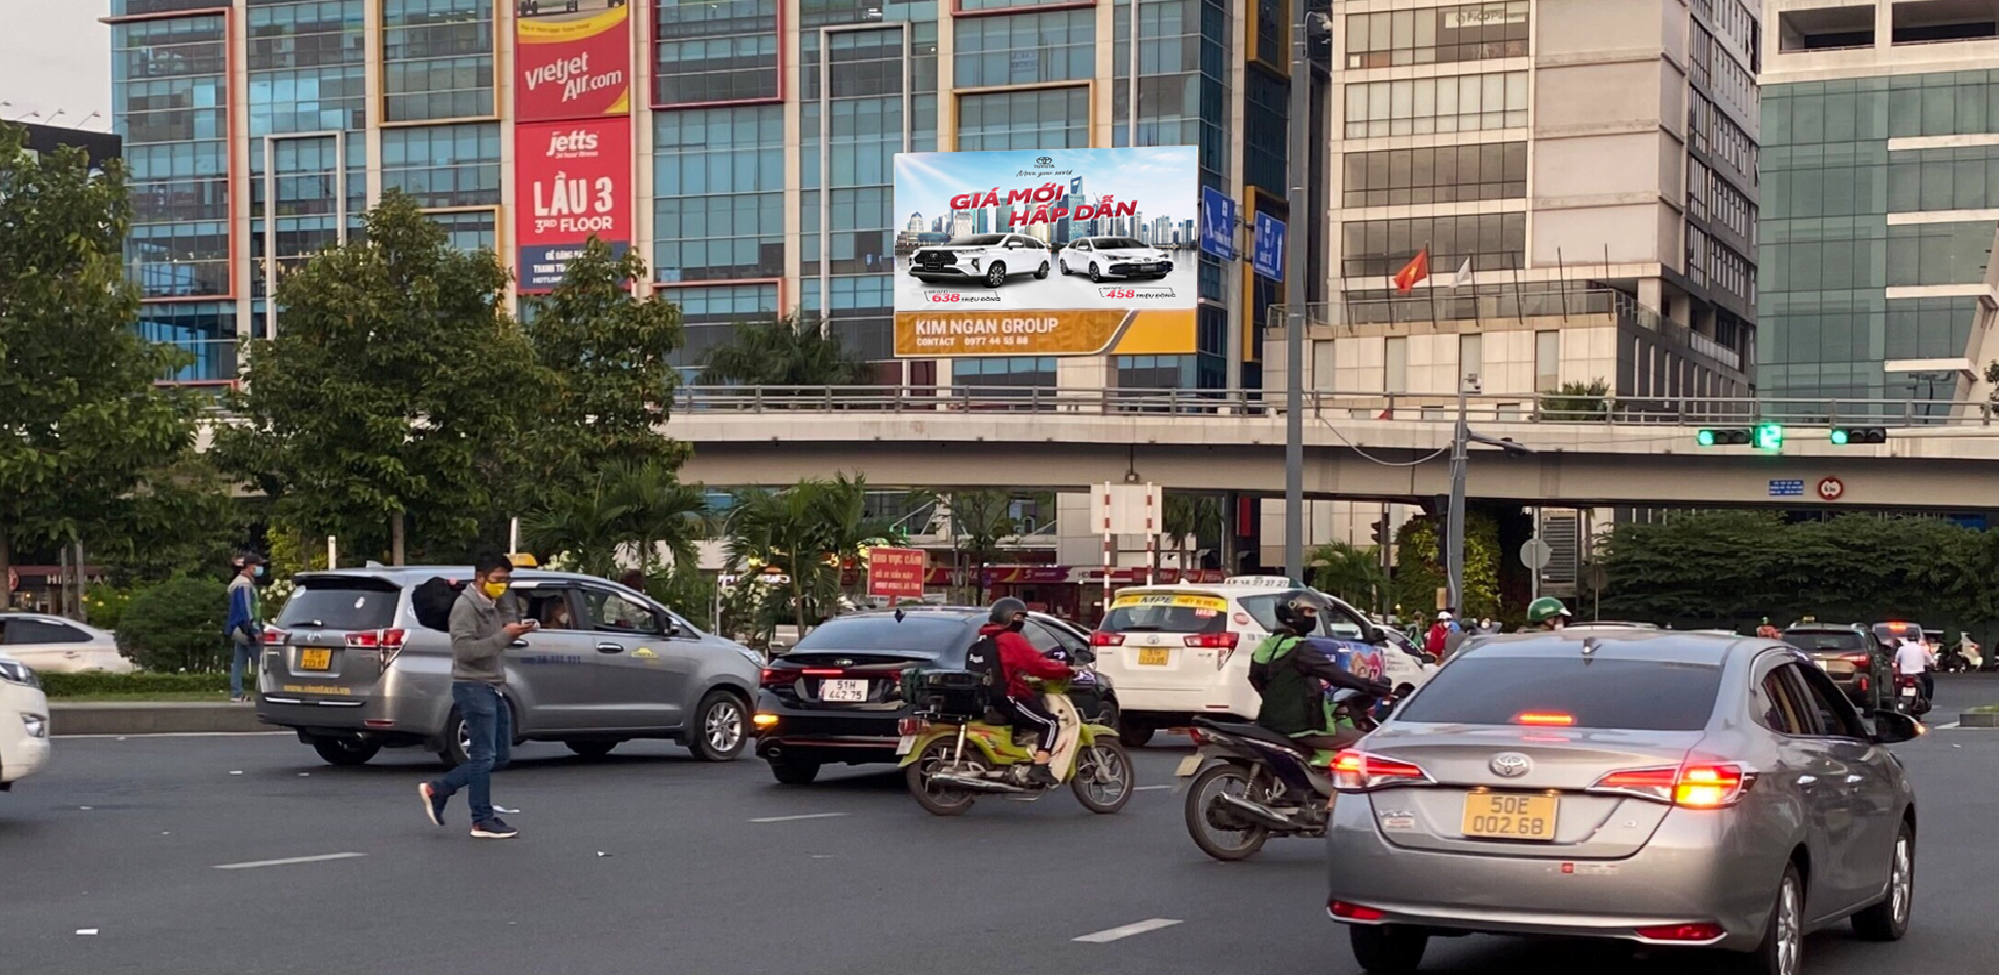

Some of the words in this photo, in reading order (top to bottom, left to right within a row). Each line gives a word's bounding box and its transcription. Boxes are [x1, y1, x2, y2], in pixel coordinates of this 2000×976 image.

[561, 70, 622, 102] Air.com
[546, 130, 598, 157] jetts
[533, 170, 588, 217] LẦU
[594, 176, 612, 213] 3
[950, 187, 1001, 211] GIÁ
[1006, 182, 1066, 206] MỚI
[1008, 203, 1069, 228] HẤP
[1073, 194, 1138, 222] DẪN
[534, 218, 557, 234] 3RD
[560, 216, 612, 233] FLOOR
[932, 292, 961, 303] 638
[1106, 289, 1135, 299] 458
[916, 319, 947, 335] KIM
[950, 318, 998, 335] NGAN
[1001, 316, 1059, 334] GROUP
[916, 337, 955, 347] CONTACT
[964, 336, 986, 346] 0977
[837, 681, 856, 690] 51H
[1491, 796, 1530, 815] 50E
[1473, 815, 1544, 835] 002.68
